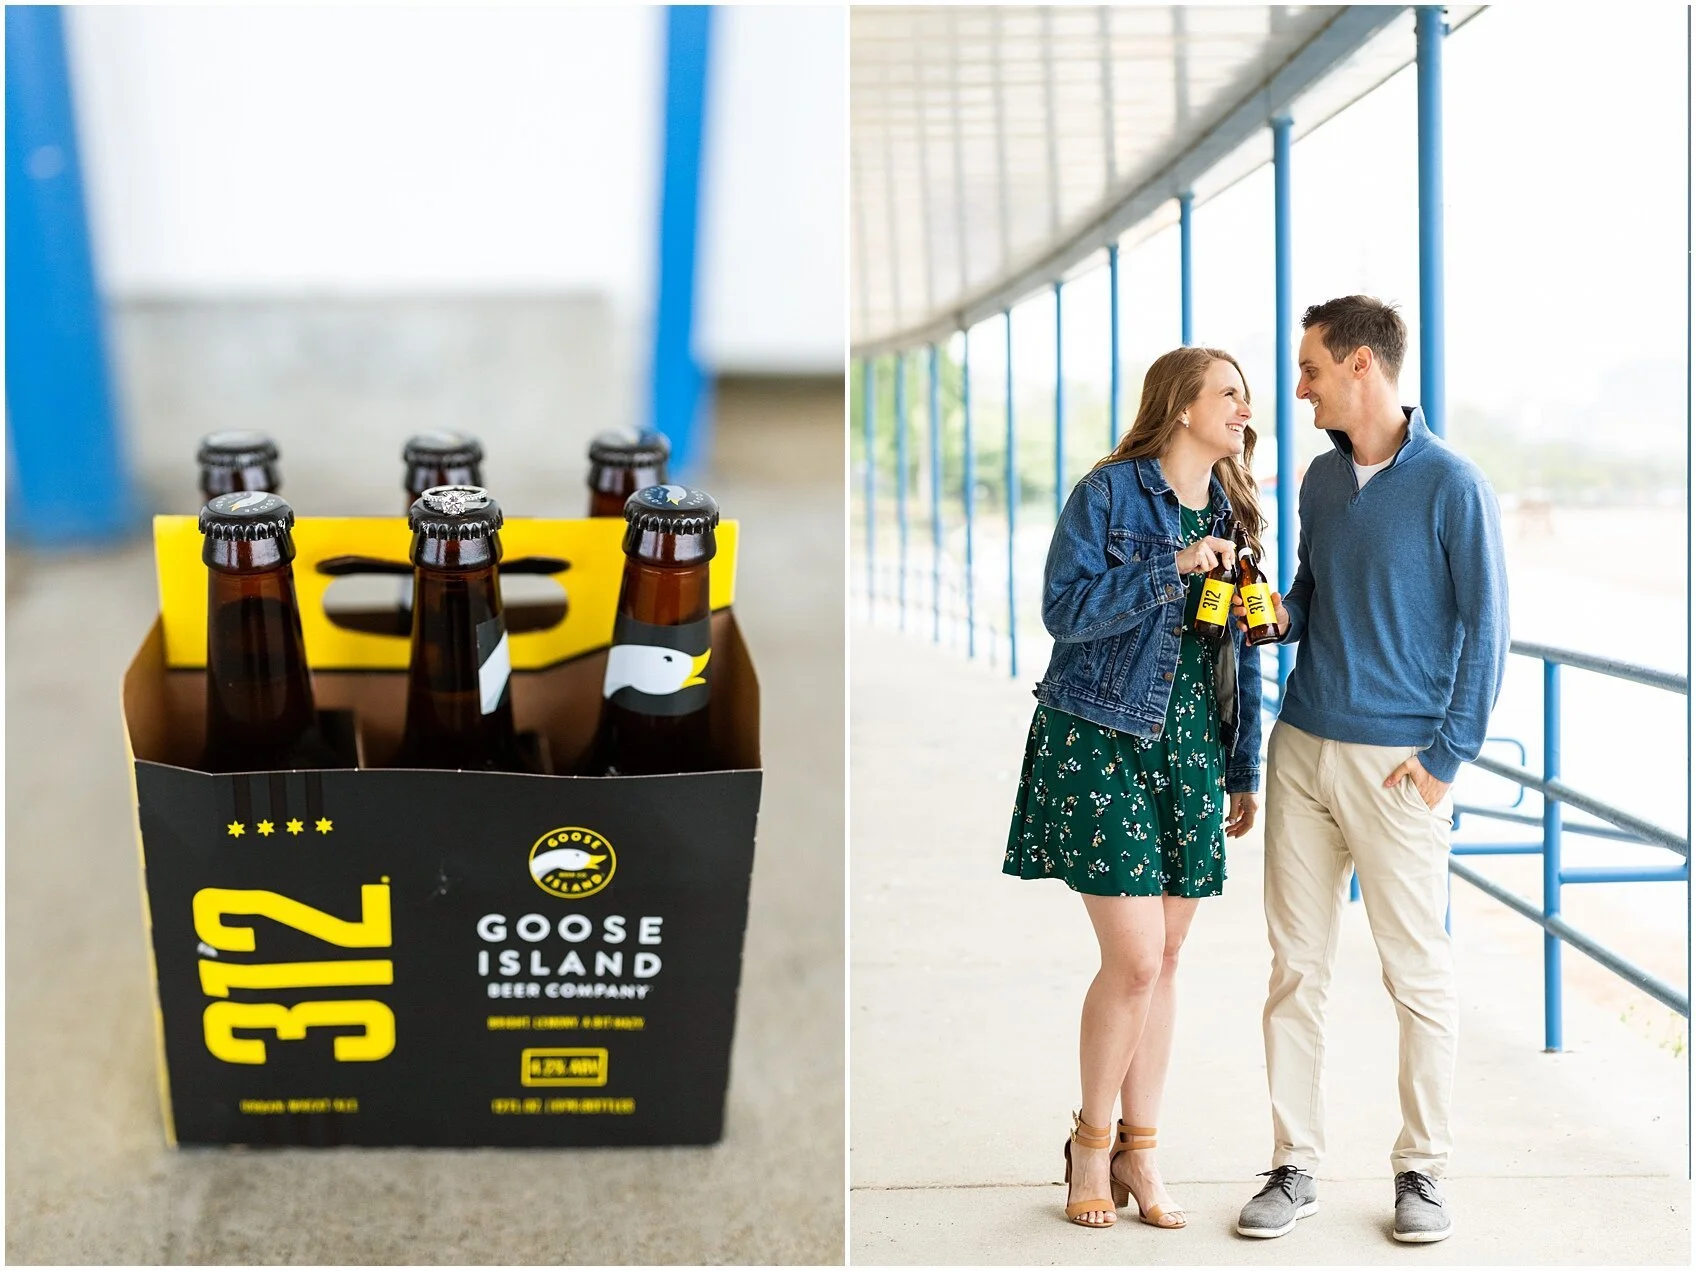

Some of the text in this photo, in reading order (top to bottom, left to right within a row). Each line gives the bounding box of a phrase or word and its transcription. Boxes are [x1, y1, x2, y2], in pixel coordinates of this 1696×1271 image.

[1203, 590, 1221, 610] 312
[1247, 595, 1265, 614] 312
[547, 831, 602, 850] GOOSE
[544, 873, 603, 892] ISLAND
[476, 913, 664, 945] GOOSE
[192, 882, 397, 1065] 312
[478, 949, 663, 979] ISLAND
[487, 982, 650, 1000] BEER COMPANY
